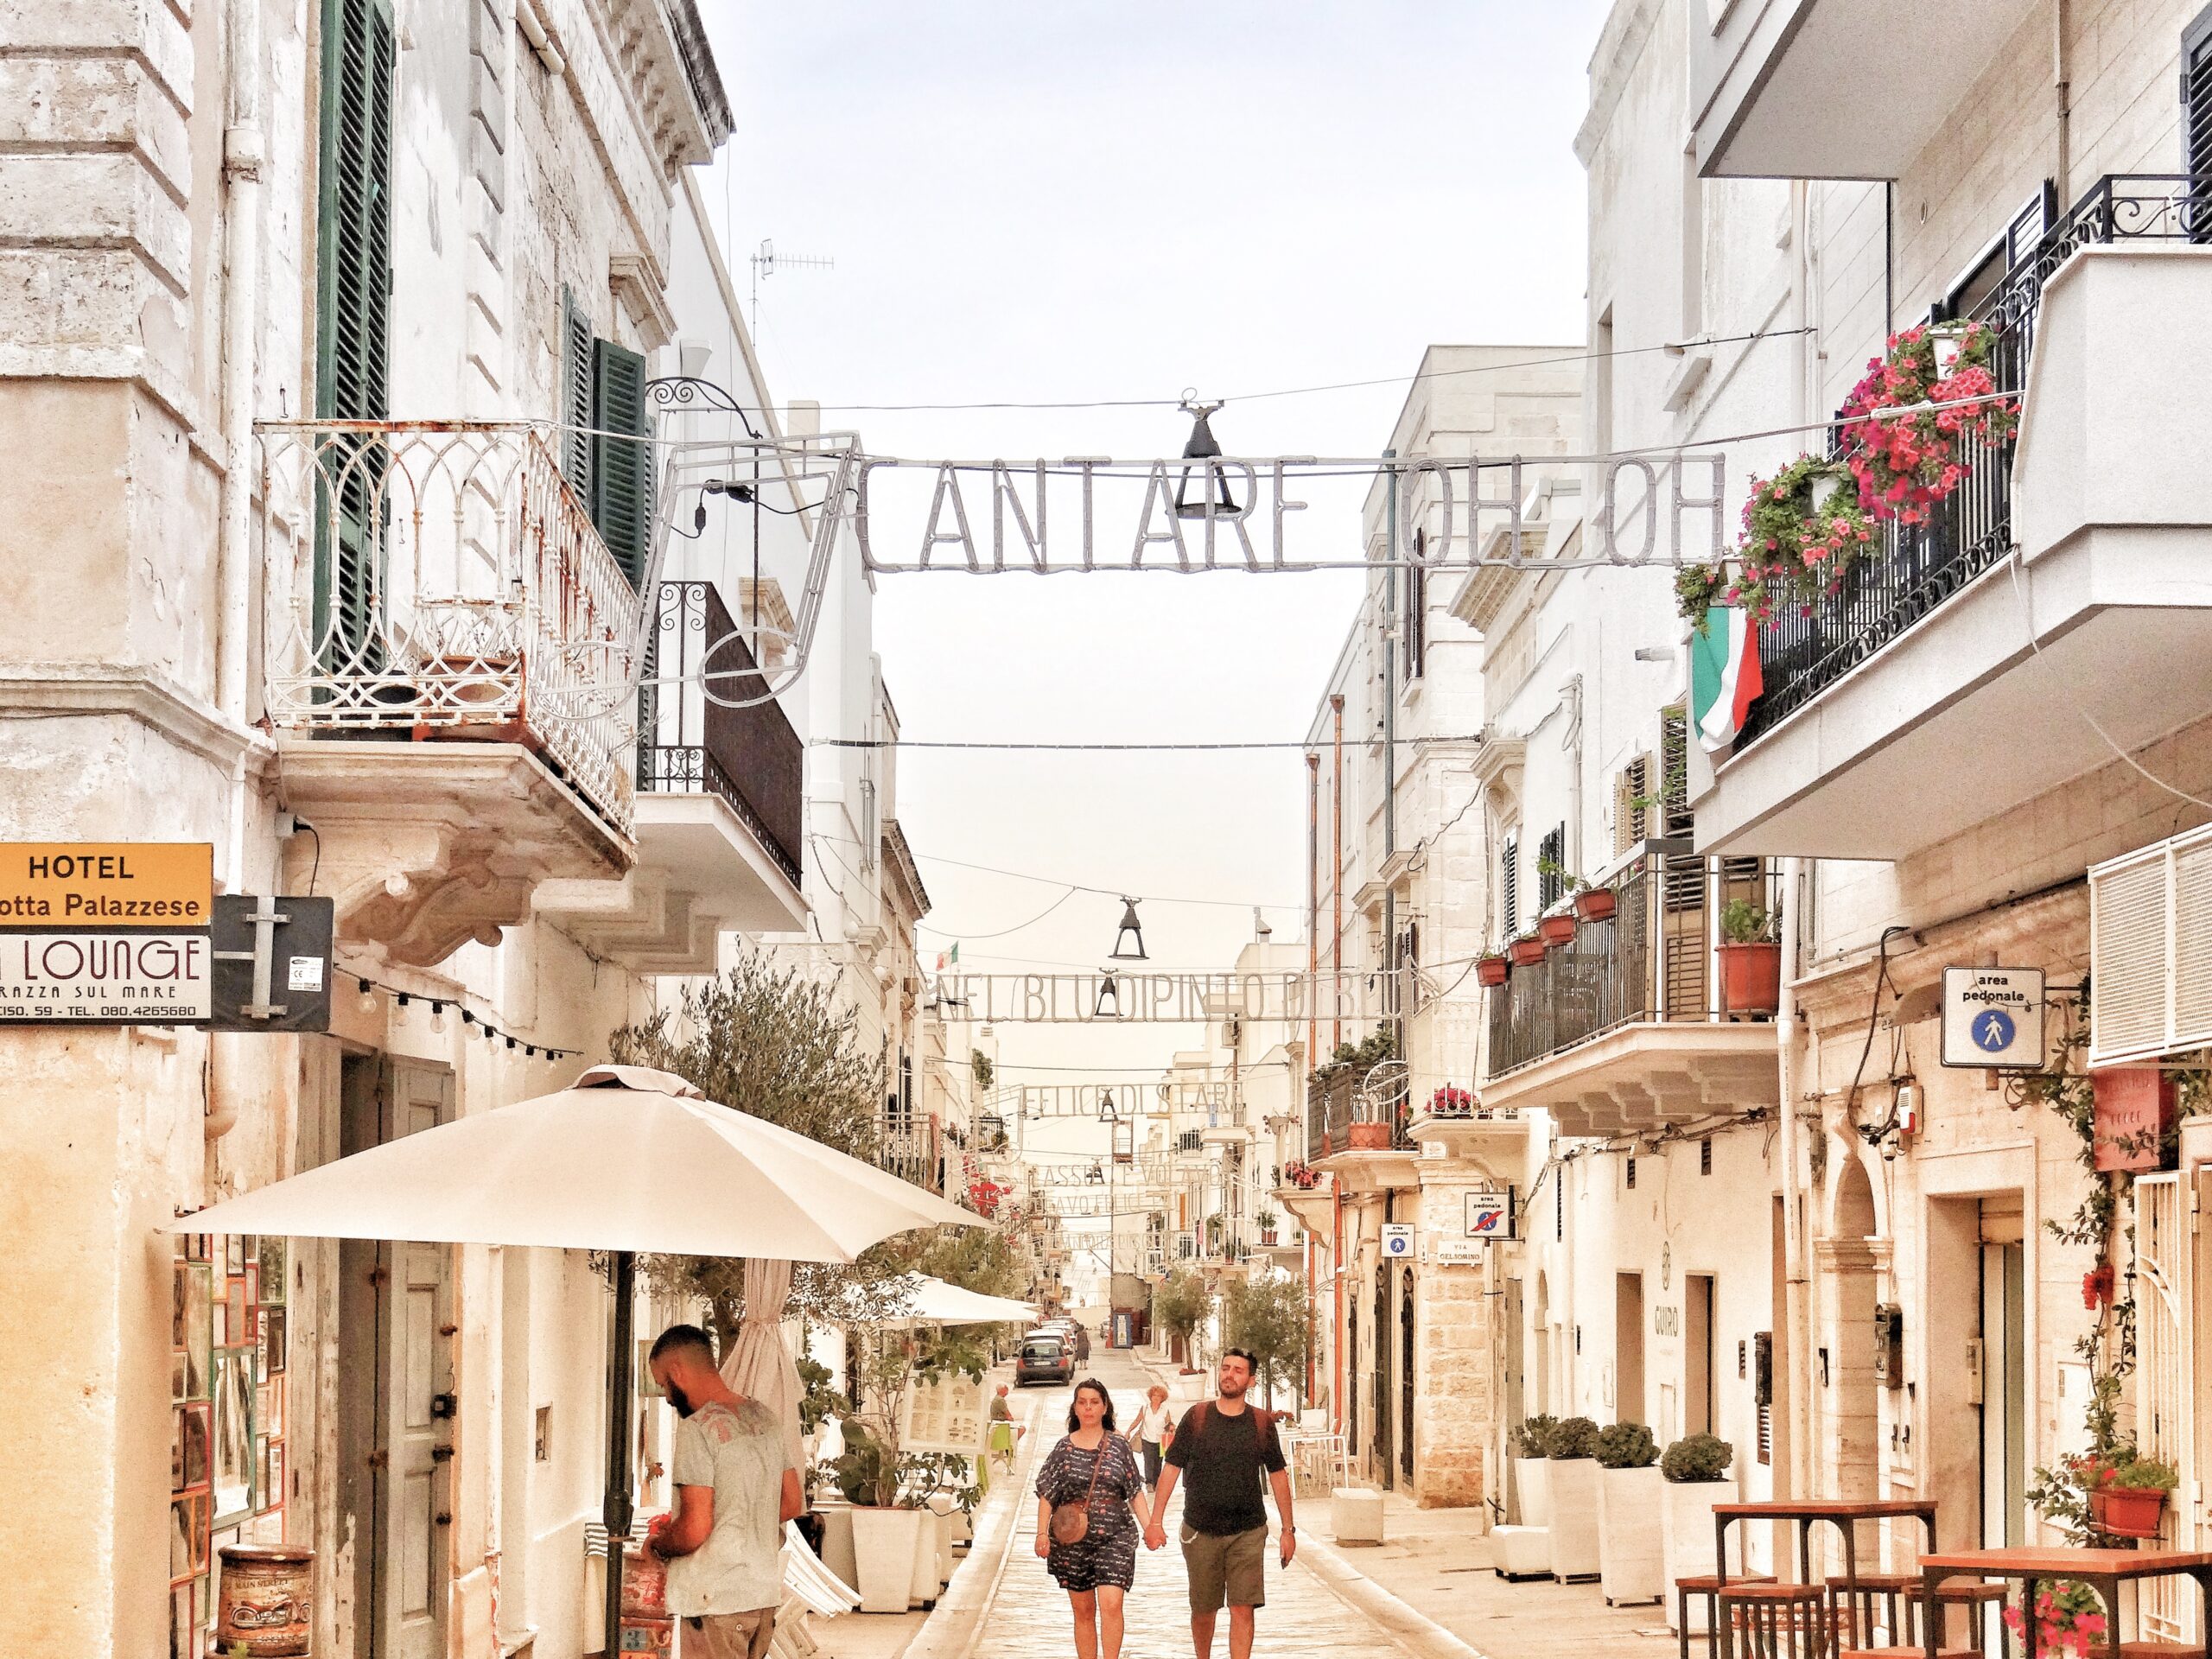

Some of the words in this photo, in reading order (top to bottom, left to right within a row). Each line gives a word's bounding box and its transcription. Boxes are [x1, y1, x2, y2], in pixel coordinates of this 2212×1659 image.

[856, 455, 1318, 574] CANTARE
[1401, 454, 1522, 568] OH
[1604, 452, 1727, 569] OH
[29, 855, 134, 879] HOTEL
[65, 893, 200, 917] Palazzese
[24, 939, 200, 980] LOUNGE
[75, 986, 107, 998] SUL
[122, 986, 176, 998] MARE
[1977, 975, 2009, 986] area
[936, 973, 1013, 1023] NEL
[1023, 973, 1096, 1023] BLU
[1114, 971, 1265, 1023] DIPINTO
[1962, 989, 2025, 1003] pedonale
[35, 1006, 52, 1017] 59
[67, 1006, 95, 1017] TEL.
[101, 1006, 196, 1017] 080.4265680
[1654, 1305, 1679, 1338] GUIRO
